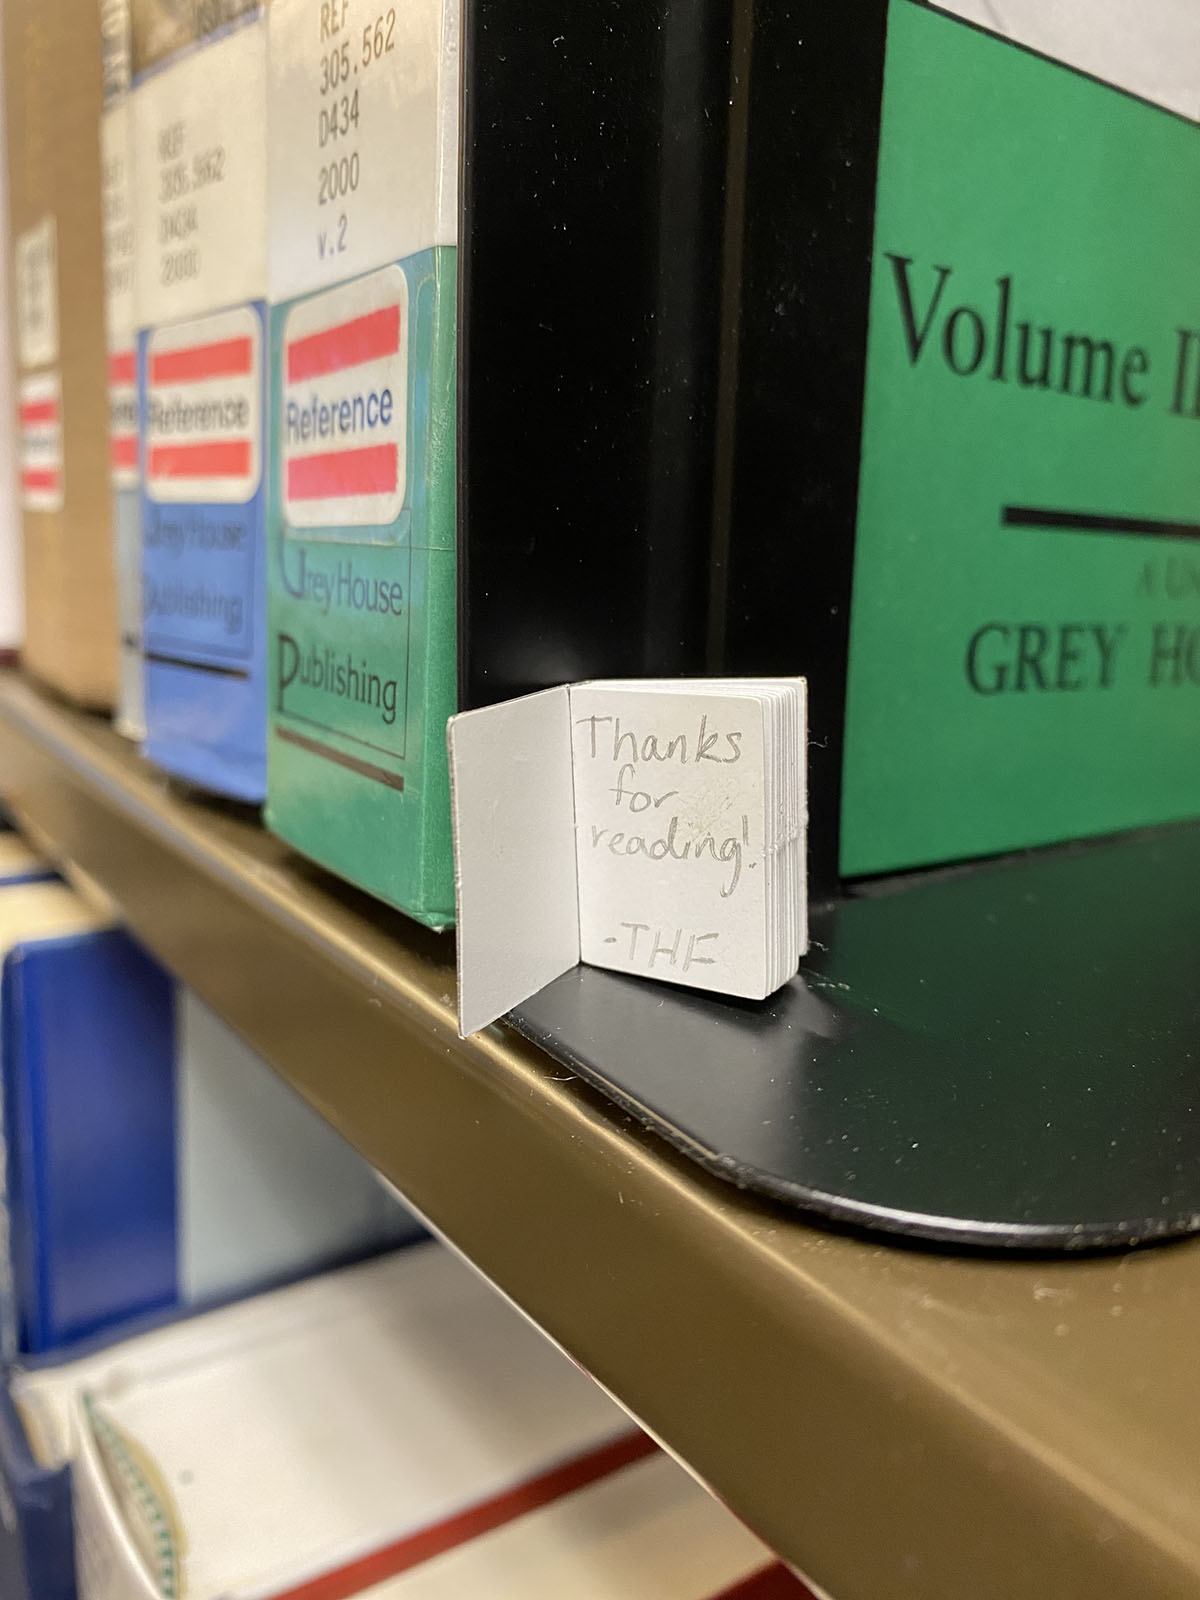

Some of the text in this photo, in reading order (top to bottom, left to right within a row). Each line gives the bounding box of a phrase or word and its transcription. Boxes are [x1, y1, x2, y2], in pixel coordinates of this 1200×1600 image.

[319, 8, 396, 96] 305.562
[318, 87, 360, 148] D434
[318, 151, 360, 206] 2000
[317, 213, 349, 260] v.2
[884, 250, 1150, 410] Volume
[287, 388, 394, 446] Reference
[336, 559, 404, 617] House
[276, 632, 399, 726] Publishing
[964, 617, 1130, 698] GREY
[576, 714, 743, 764] Thanks
[608, 763, 680, 813] for
[591, 814, 757, 898] reading!
